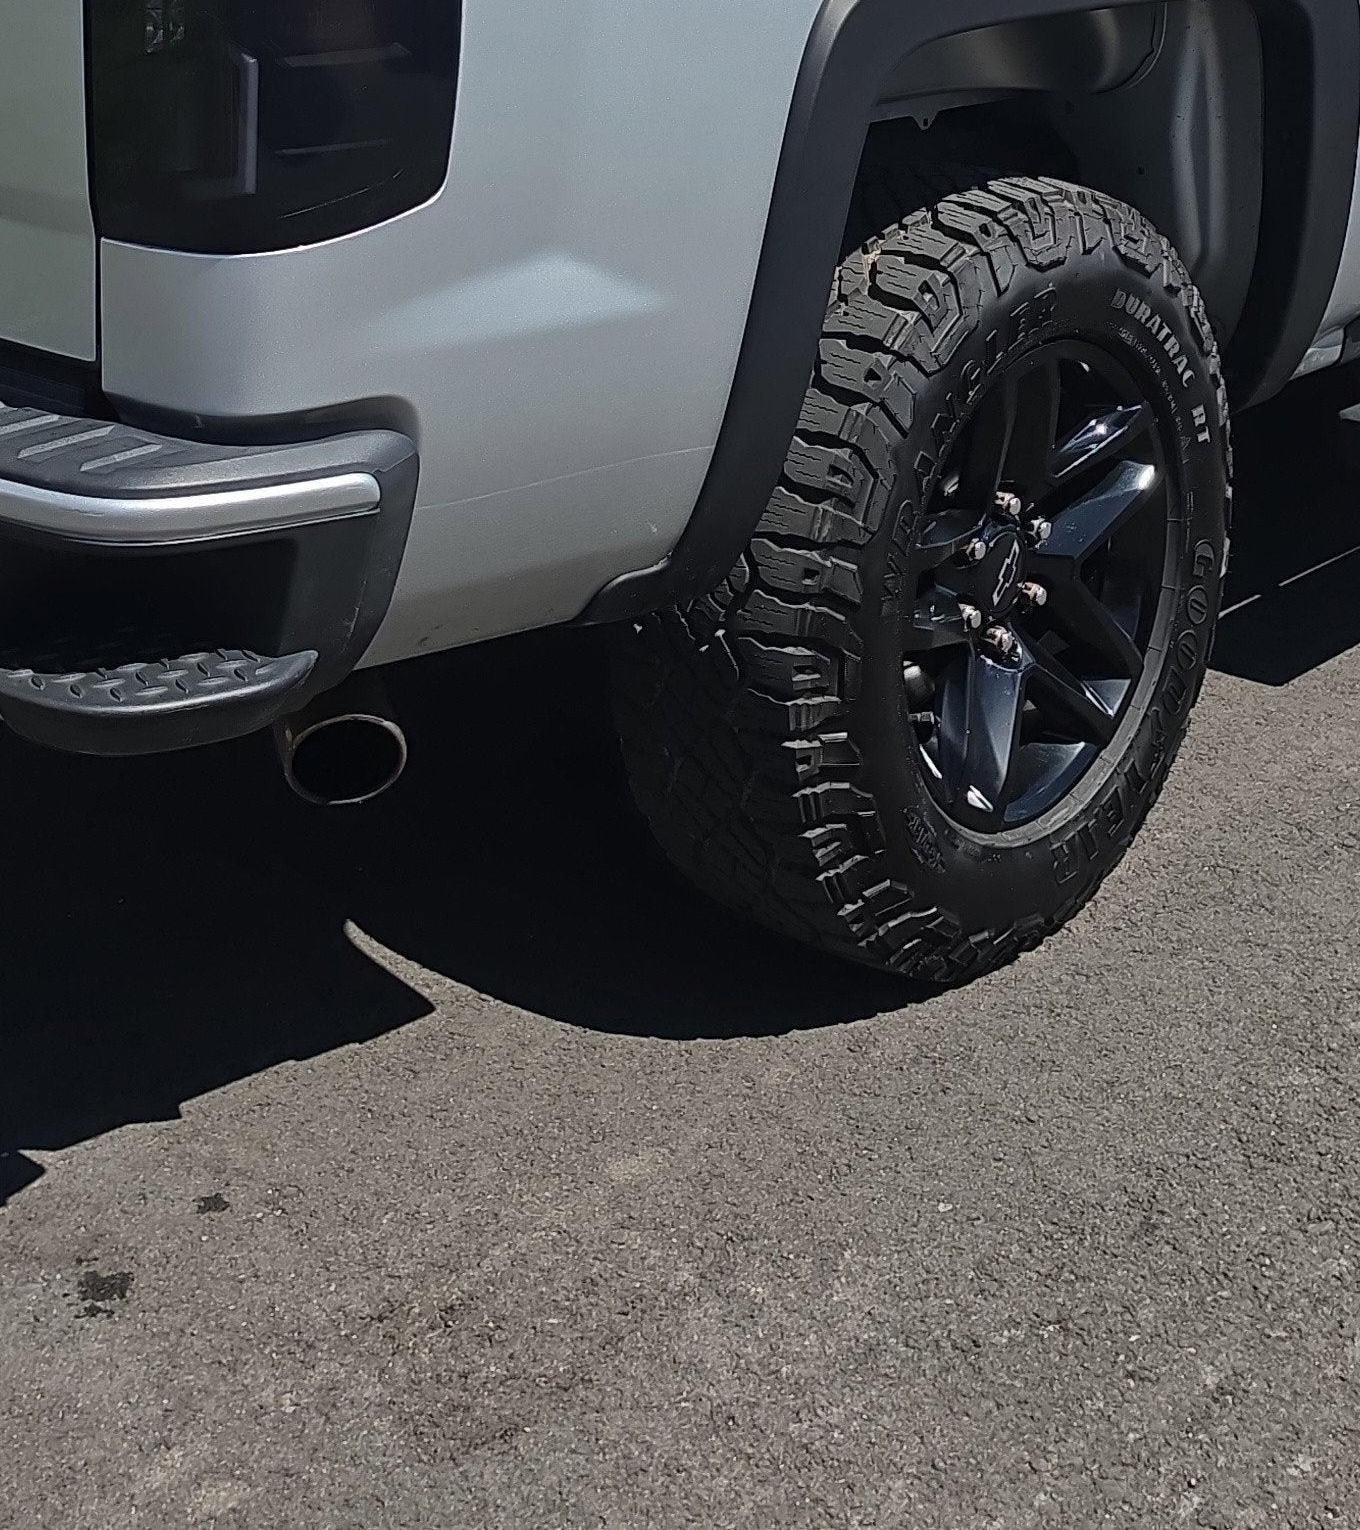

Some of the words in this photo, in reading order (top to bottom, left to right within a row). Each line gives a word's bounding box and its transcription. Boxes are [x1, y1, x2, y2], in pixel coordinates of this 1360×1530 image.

[1110, 287, 1197, 391] DURATRAC
[1190, 403, 1212, 444] RT
[1049, 538, 1217, 885] GOODYEAR
